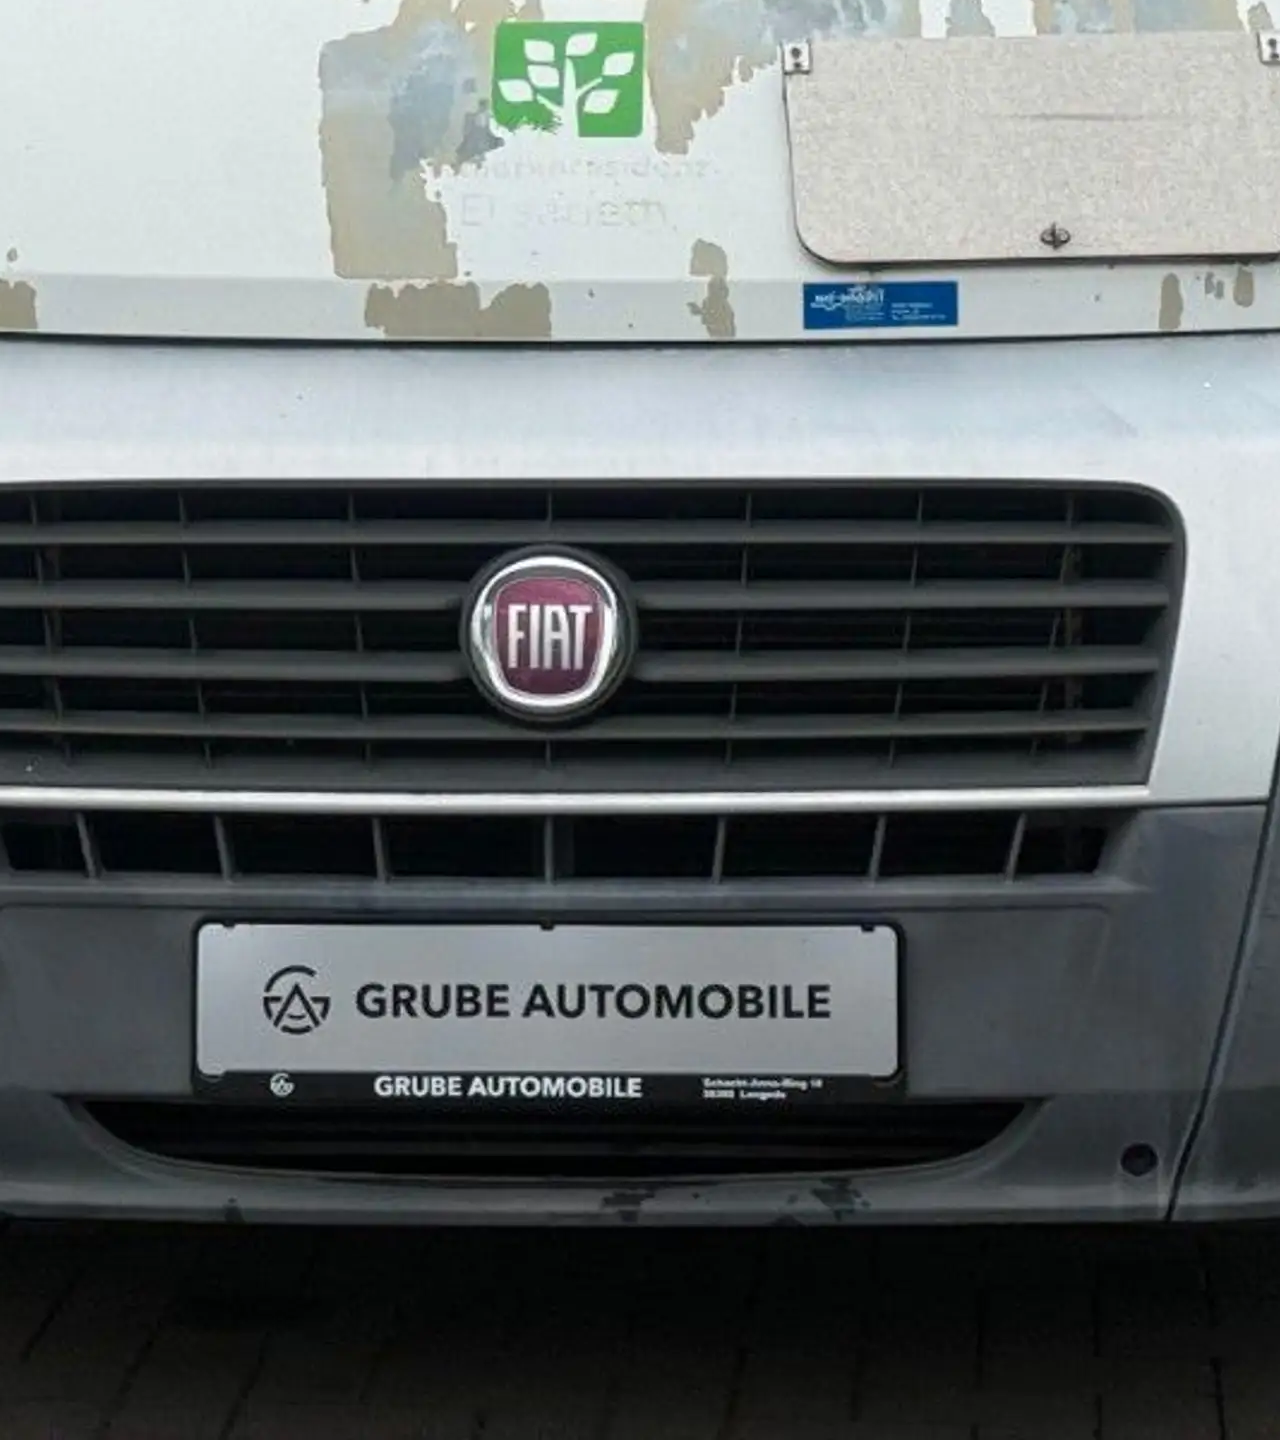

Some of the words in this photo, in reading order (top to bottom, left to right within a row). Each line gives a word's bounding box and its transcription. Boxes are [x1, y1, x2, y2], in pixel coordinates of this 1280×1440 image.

[507, 603, 593, 671] FIAT
[355, 982, 511, 1020] GRUBE
[521, 982, 831, 1020] AUTOMOBILE
[374, 1073, 463, 1098] GRUBE
[467, 1075, 642, 1098] AUTOMOBILE
